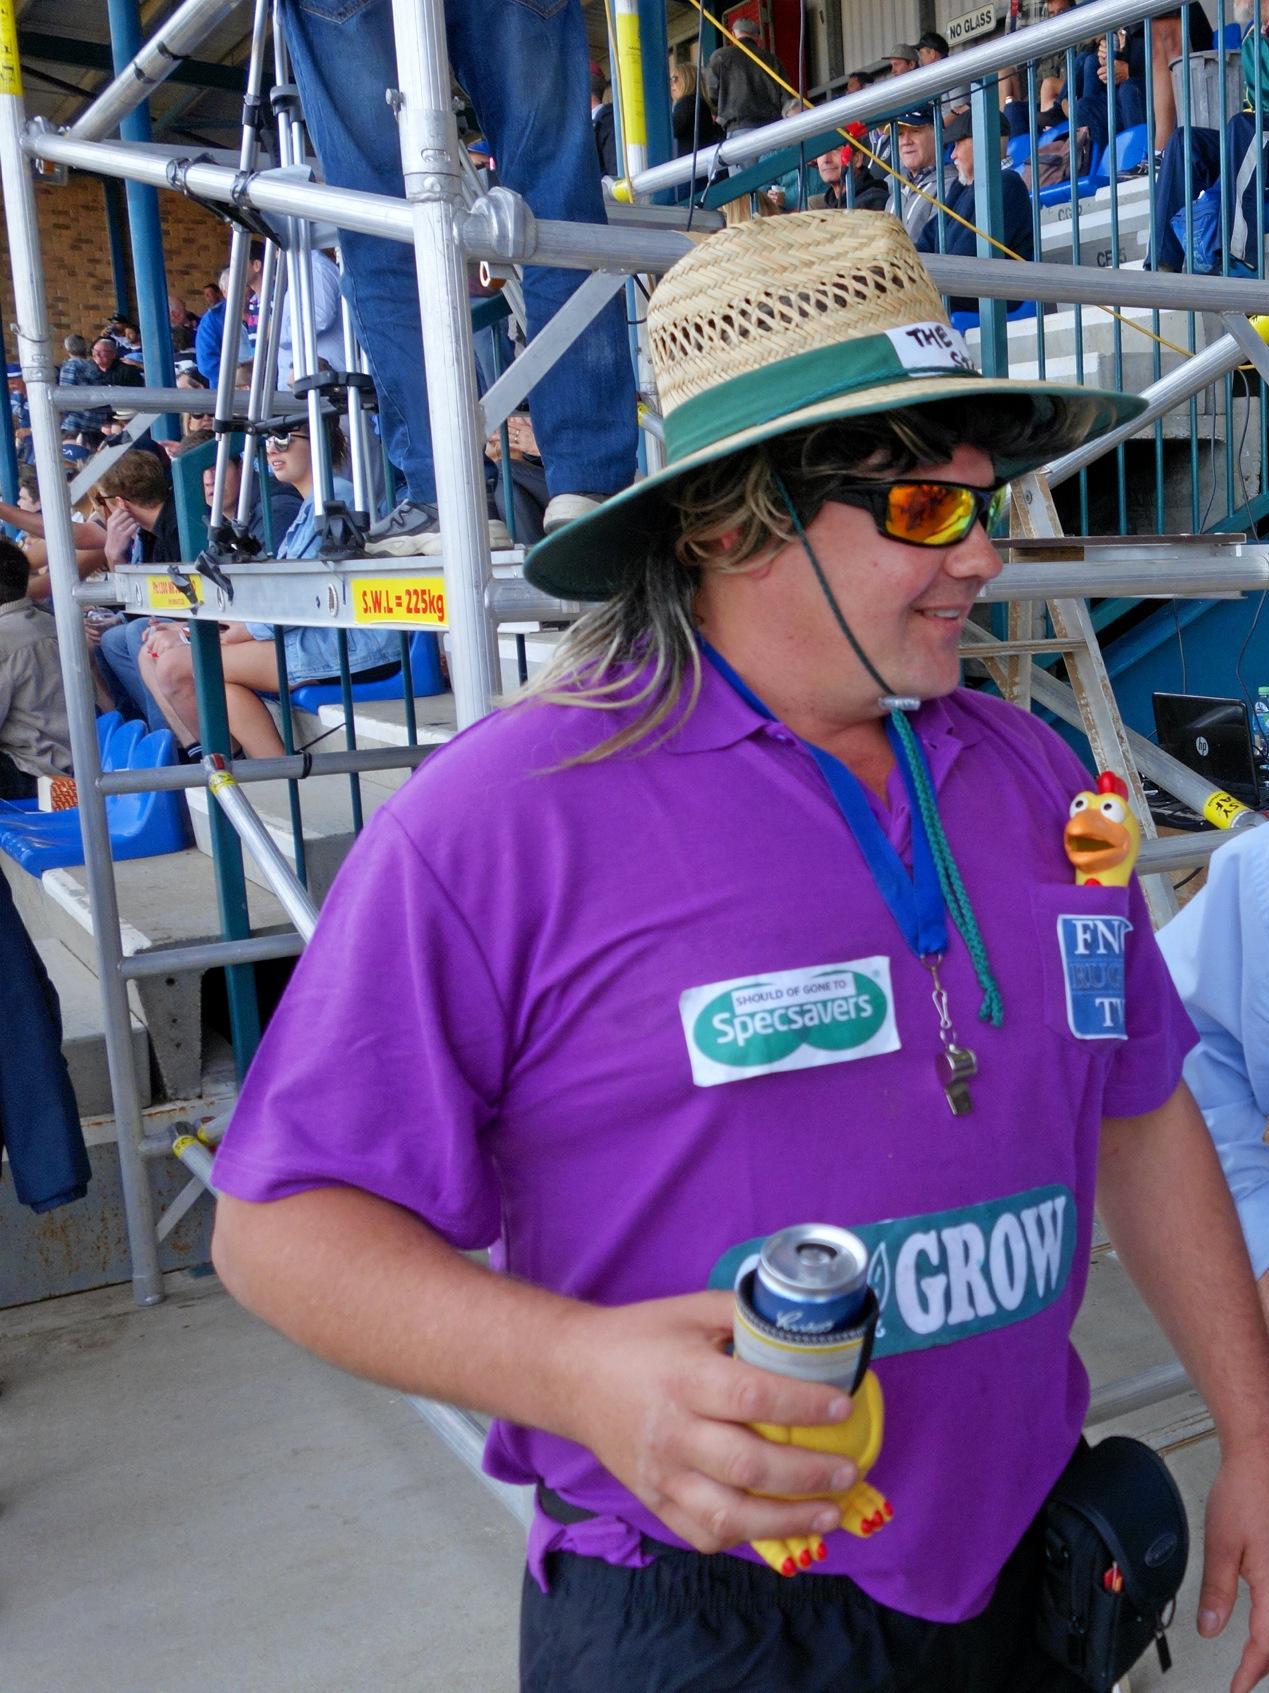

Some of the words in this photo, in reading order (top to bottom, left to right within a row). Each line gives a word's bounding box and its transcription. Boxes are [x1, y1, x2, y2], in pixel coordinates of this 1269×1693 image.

[949, 23, 962, 39] NO
[964, 10, 992, 33] GLASS
[905, 324, 953, 349] THE
[362, 590, 393, 614] S.W.L
[405, 589, 444, 622] 225kg
[736, 990, 784, 1007] SHOULD
[787, 986, 801, 998] OF
[803, 981, 831, 995] GONE
[832, 979, 847, 990] TO
[712, 995, 873, 1047] Specsavers
[895, 1195, 1067, 1335] GROW
